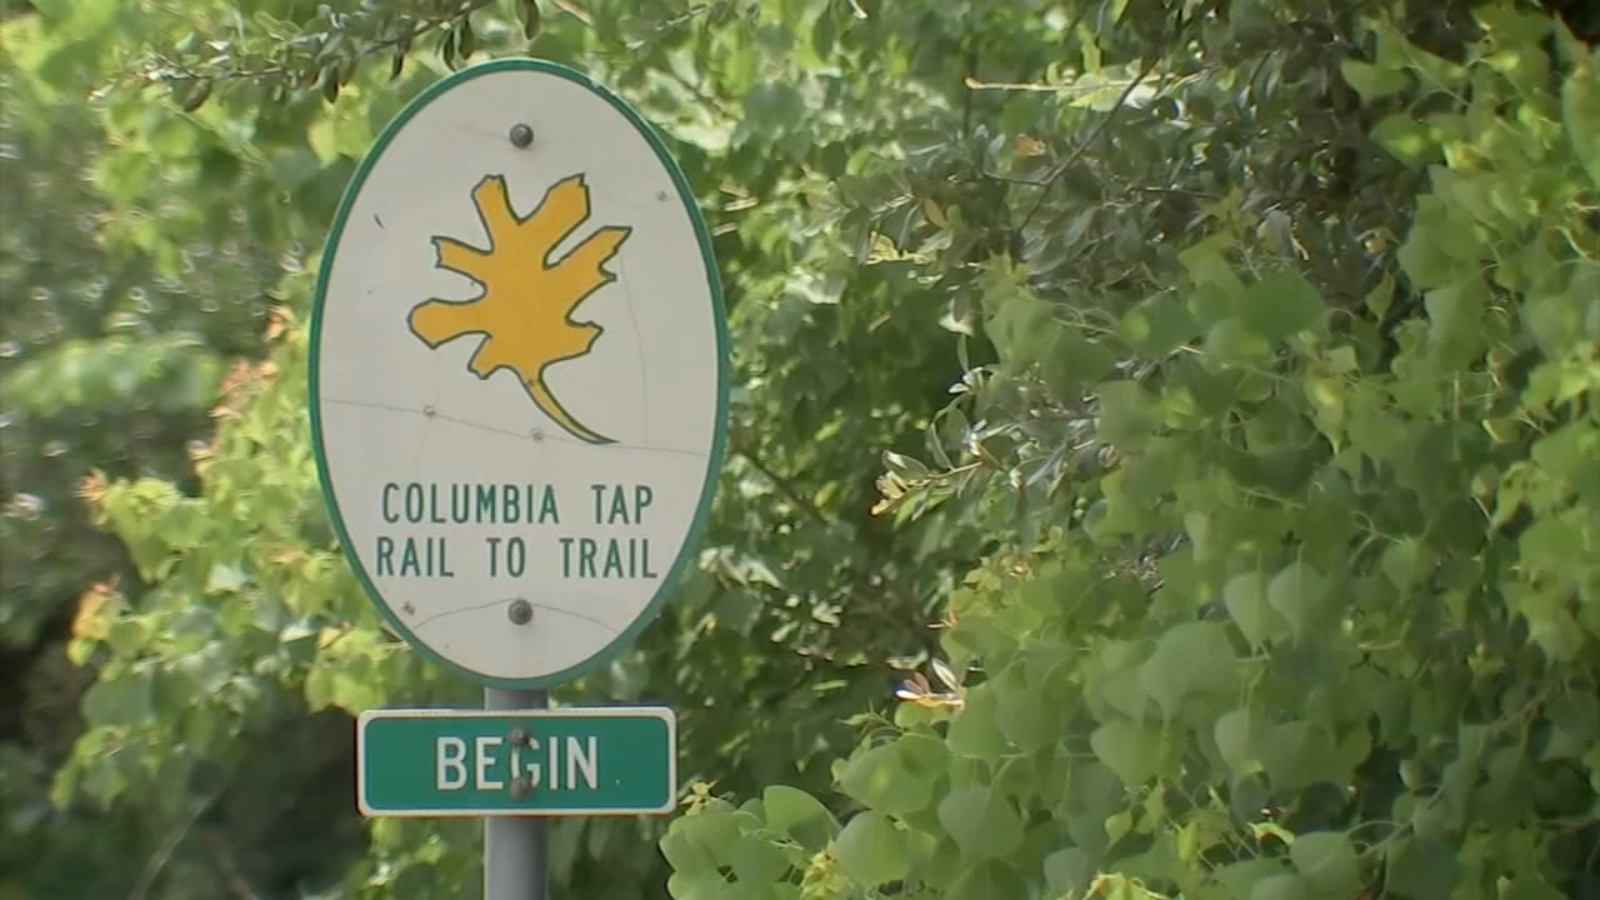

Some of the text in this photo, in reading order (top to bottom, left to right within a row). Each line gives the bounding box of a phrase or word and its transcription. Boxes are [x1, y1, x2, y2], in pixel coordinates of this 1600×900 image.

[382, 482, 654, 525] COLUMBIA TAP
[376, 536, 658, 579] RAIL TO TRAIL
[436, 736, 598, 790] BEGIN
